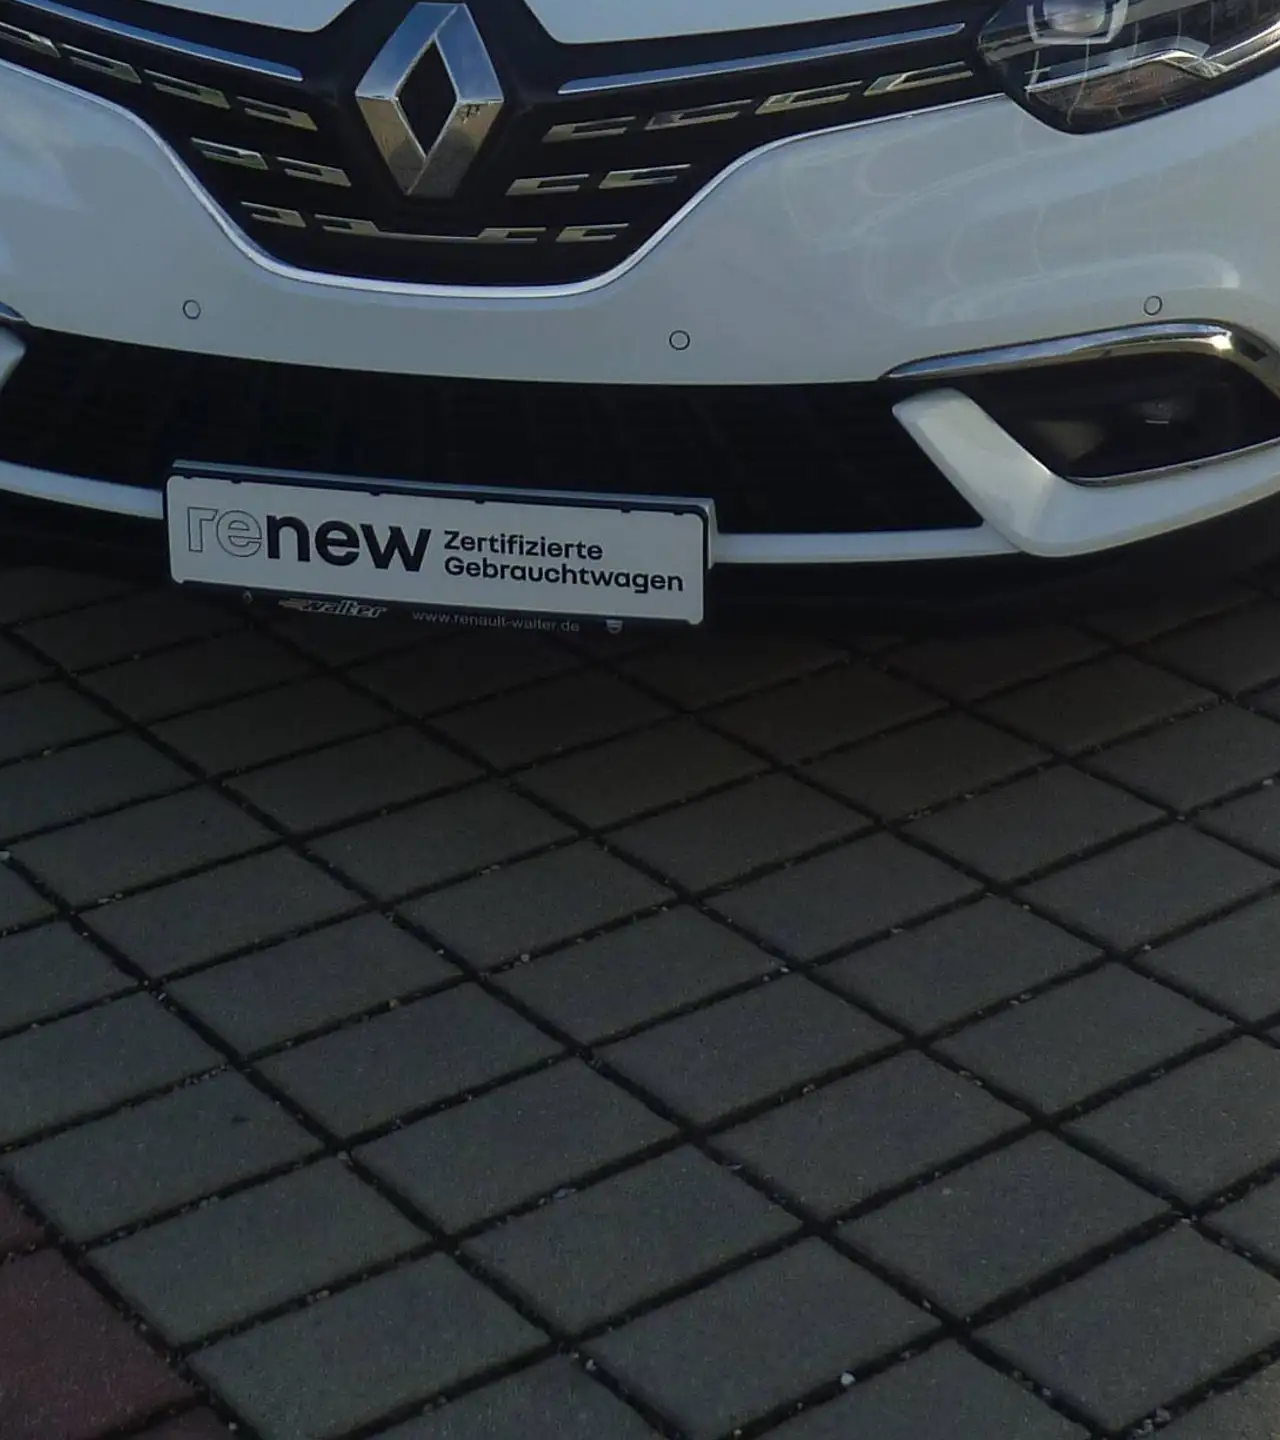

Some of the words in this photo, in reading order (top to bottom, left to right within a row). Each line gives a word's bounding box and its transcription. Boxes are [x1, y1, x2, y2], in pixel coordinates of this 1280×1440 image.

[186, 506, 431, 572] renew
[444, 530, 604, 561] Zertifizierte
[444, 556, 684, 593] Gebrauchtwagen
